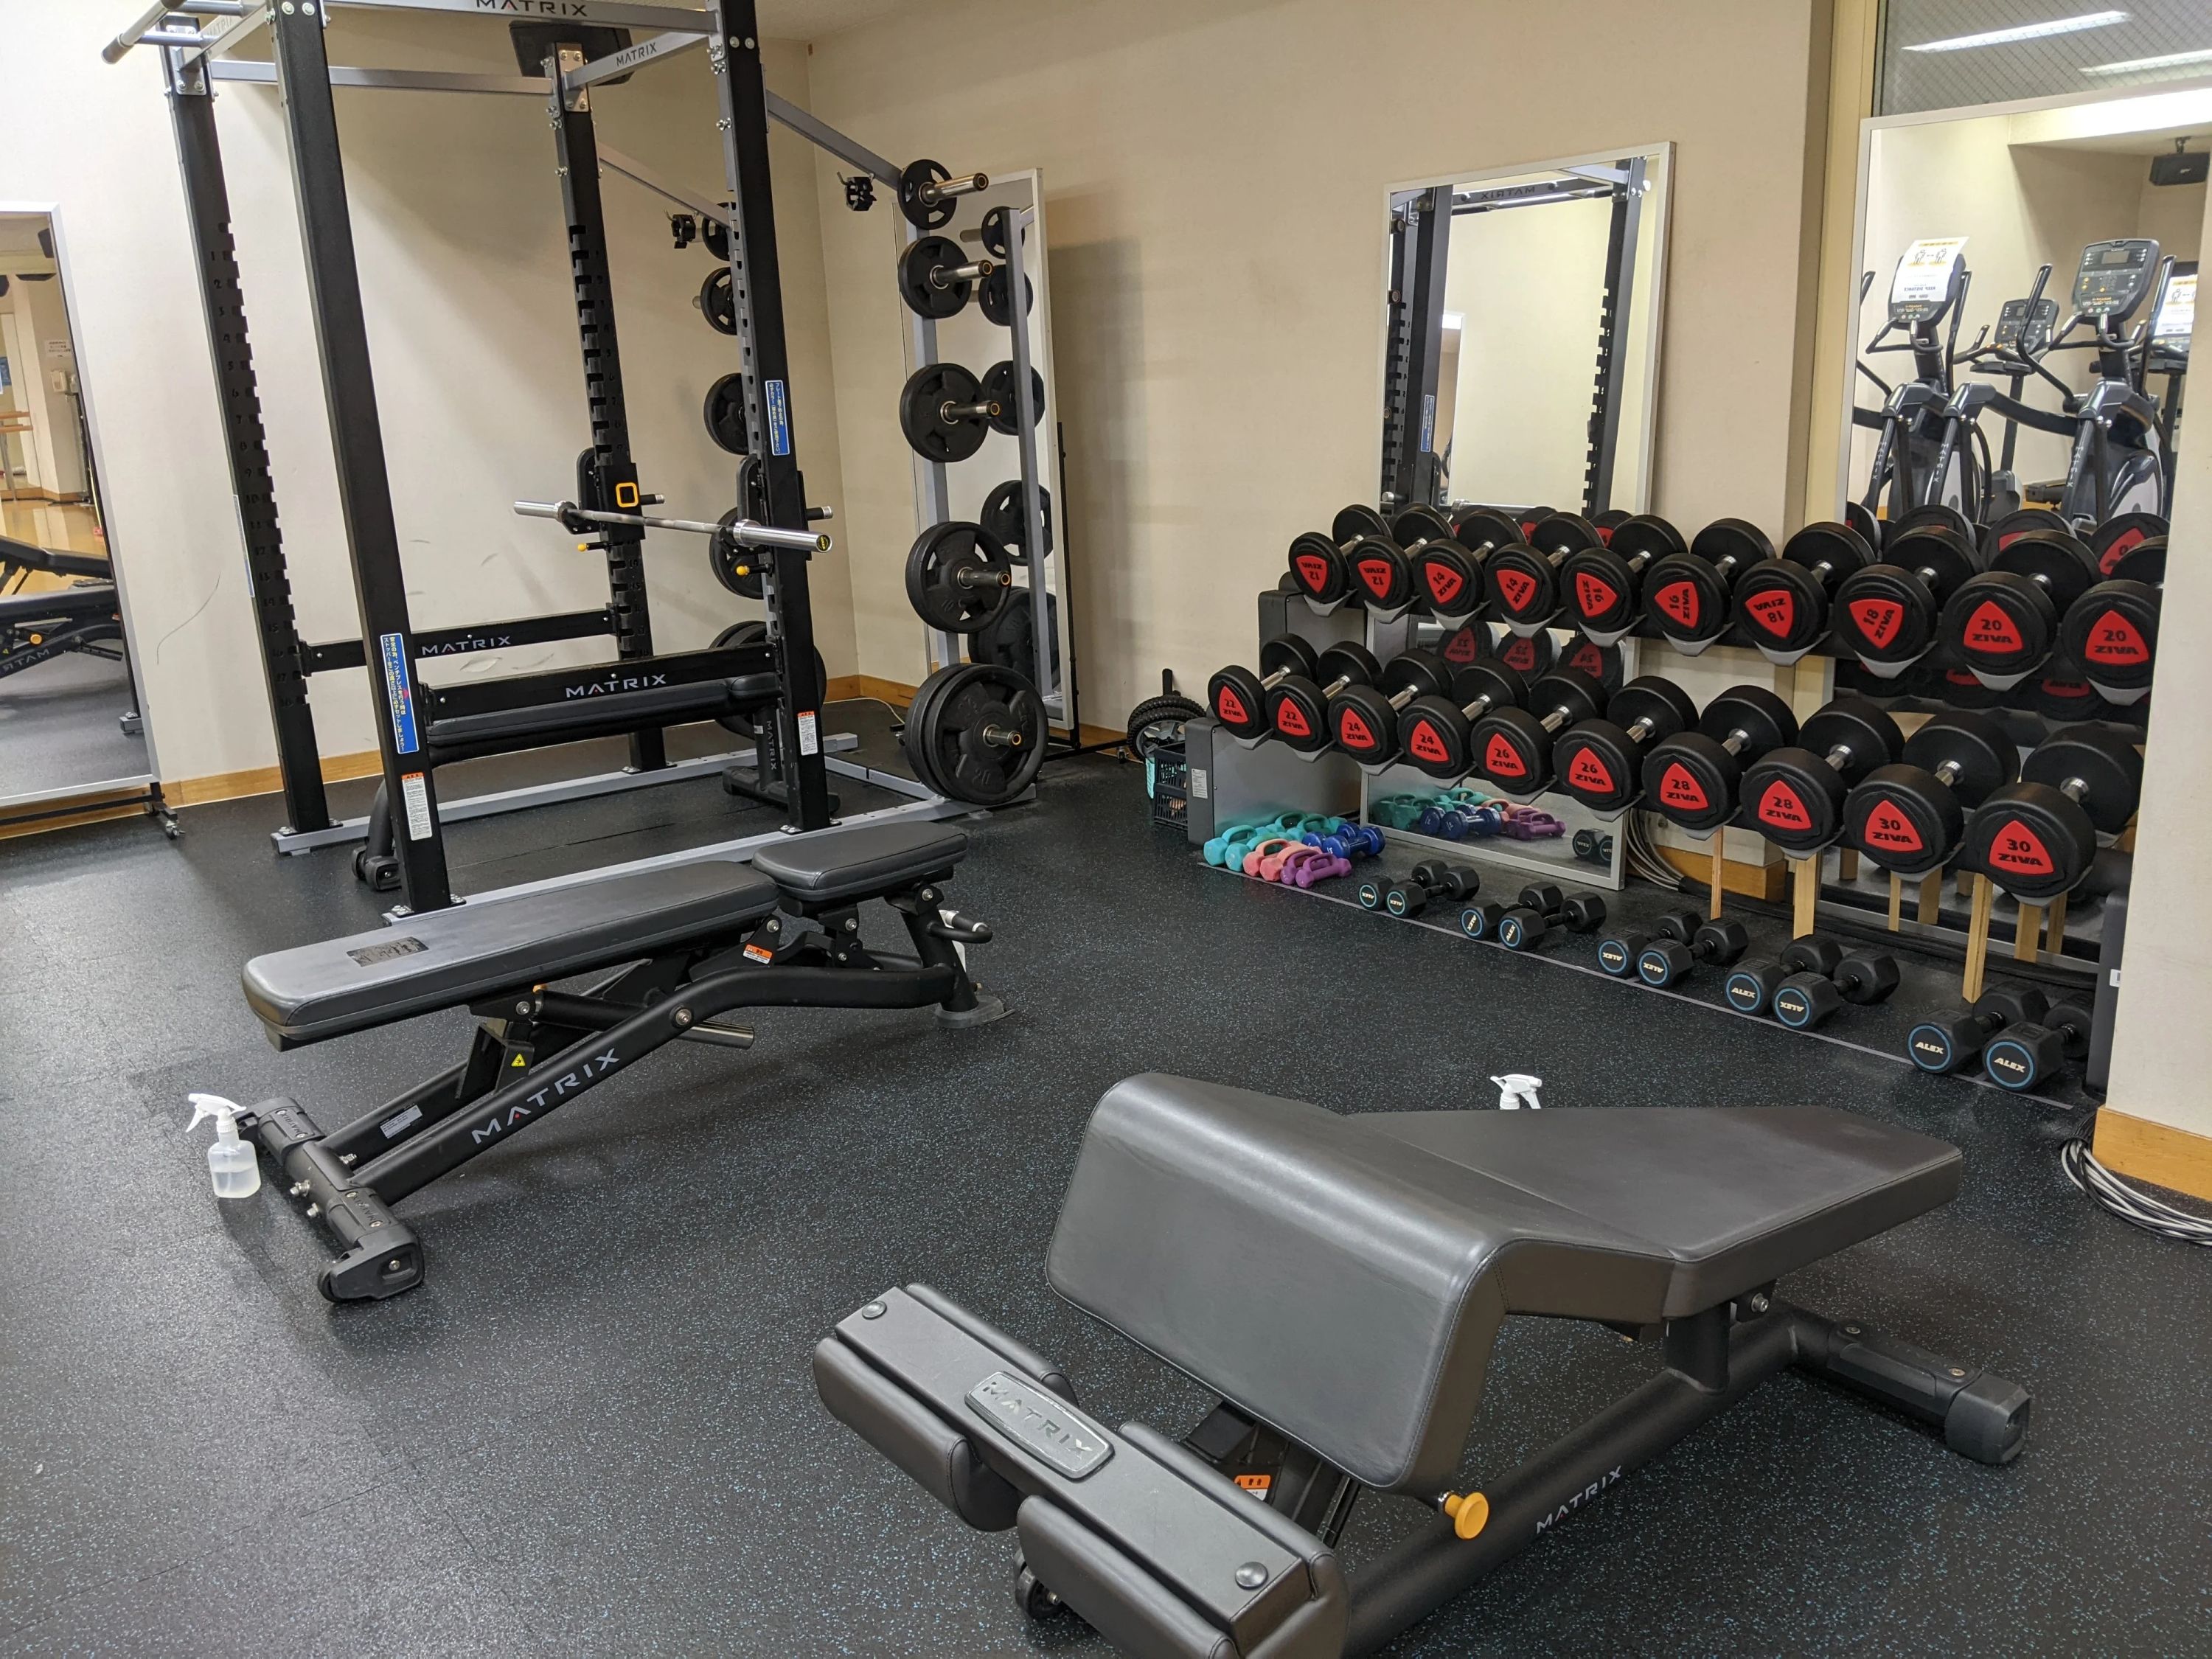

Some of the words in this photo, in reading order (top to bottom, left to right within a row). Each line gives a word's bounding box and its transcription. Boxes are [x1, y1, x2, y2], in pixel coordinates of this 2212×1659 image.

[476, 0, 588, 16] MATRIX
[616, 42, 657, 67] MATRIX
[1301, 562, 1323, 570] ZIVA
[1363, 566, 1387, 574] ZIVA
[1309, 570, 1319, 581] 12
[1373, 576, 1385, 585] 12
[1433, 572, 1445, 585] 14
[1438, 577, 1457, 597] ZIVA
[1506, 577, 1518, 591] 14
[1513, 581, 1530, 604] ZIVA
[1582, 580, 1593, 611] ZIVA
[1593, 588, 1603, 602] 16
[1669, 595, 1680, 610] 16
[1682, 588, 1690, 619] ZIVA
[1753, 598, 1786, 611] ZIVA
[1767, 610, 1785, 623] 18
[1863, 608, 1879, 625] 18
[1874, 609, 1895, 640] ZIVA
[1981, 619, 2002, 630] 20
[1972, 633, 2014, 644] ZIVA
[2103, 630, 2127, 641] 20
[422, 636, 510, 655] MATRIX
[2094, 645, 2140, 655] ZIVA
[566, 674, 667, 698] MATRIX
[1224, 699, 1236, 708] 22
[1224, 709, 1243, 718] ZIVA
[1284, 711, 1297, 721] 22
[1281, 720, 1304, 730] ZIVA
[1347, 723, 1360, 731] 24
[1345, 732, 1368, 742] ZIVA
[1420, 734, 1433, 745] 24
[767, 720, 776, 770] MATRIX
[1416, 745, 1441, 755] ZIVA
[1495, 748, 1509, 758] 26
[1491, 759, 1518, 770] ZIVA
[1582, 762, 1598, 773] 26
[1575, 773, 1606, 786] ZIVA
[1672, 779, 1690, 790] 28
[1666, 791, 1699, 802] ZIVA
[1774, 797, 1793, 809] 28
[1765, 809, 1802, 822] ZIVA
[1879, 818, 1901, 831] 30
[1872, 832, 1913, 844] ZIVA
[2007, 838, 2031, 852] 30
[1997, 852, 2044, 866] ZIVA
[1362, 891, 1374, 900] ALEX
[1390, 899, 1402, 907] ALEX
[1467, 915, 1478, 931] ALEX
[1506, 925, 1516, 941] ALEX
[1602, 952, 1622, 961] ALEX
[1643, 963, 1664, 973] ALEX
[1731, 987, 1756, 998] ALEX
[1780, 1001, 1805, 1012] ALEX
[1916, 1042, 1944, 1054] ALEX
[1994, 1057, 2025, 1073] ALEX
[471, 1048, 619, 1144] MATRIX
[983, 1382, 1092, 1459] MATRIX
[1536, 1464, 1622, 1534] MATRIX
